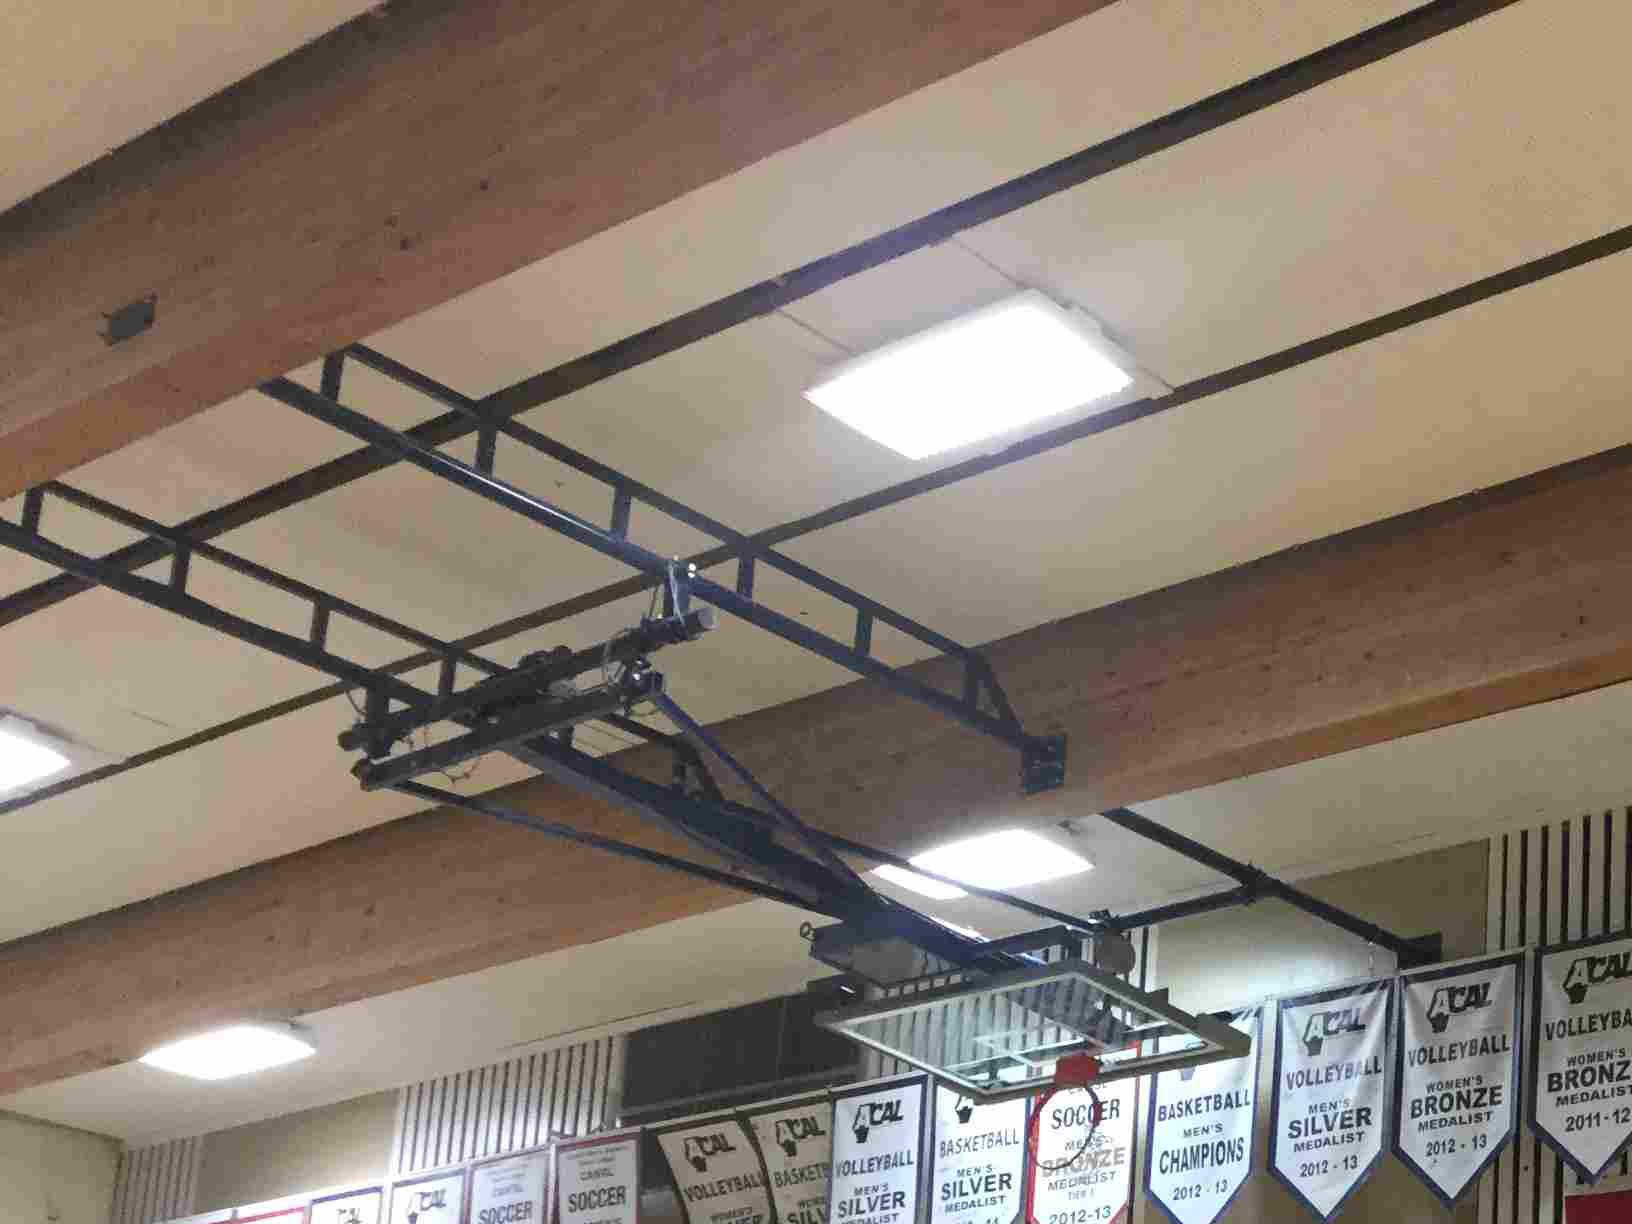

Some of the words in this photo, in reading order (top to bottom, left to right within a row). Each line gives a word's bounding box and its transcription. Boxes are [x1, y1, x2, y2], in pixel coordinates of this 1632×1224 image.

[1408, 1034, 1510, 1067] VOLLEYBALL
[1567, 1048, 1626, 1067] WOMEN'S
[1287, 1055, 1382, 1090] VOLLEYBALL
[1426, 1075, 1483, 1094] WOMEN'S
[1051, 1099, 1120, 1129] SOCCER
[1158, 1089, 1250, 1122] BASKETBALL
[1309, 1100, 1350, 1114] MEN'S
[1411, 1086, 1503, 1119] BRONZE
[1183, 1123, 1223, 1138] MEN'S
[1288, 1107, 1372, 1139] SILVER
[1418, 1112, 1493, 1132] MEDALIST
[940, 1129, 1019, 1159] BASKETBALL
[1294, 1132, 1365, 1152] MEDALIST
[1426, 1139, 1455, 1157] 2012
[1472, 1134, 1487, 1148] 13
[835, 1150, 914, 1178] VOLLEYBALL
[1159, 1138, 1244, 1174] CHAMPIONS
[1300, 1160, 1328, 1177] 2012
[1343, 1155, 1358, 1170] 13
[957, 1165, 992, 1177] MEN'S
[1048, 1171, 1116, 1191] MEDALIST
[854, 1184, 889, 1195] MEN'S
[941, 1173, 1012, 1201] SILVER
[1173, 1185, 1201, 1200] 2012
[1215, 1180, 1227, 1194] 13
[569, 1186, 626, 1213] SOCCER
[837, 1191, 905, 1218] SILVER
[945, 1196, 1007, 1214] MEDALIST
